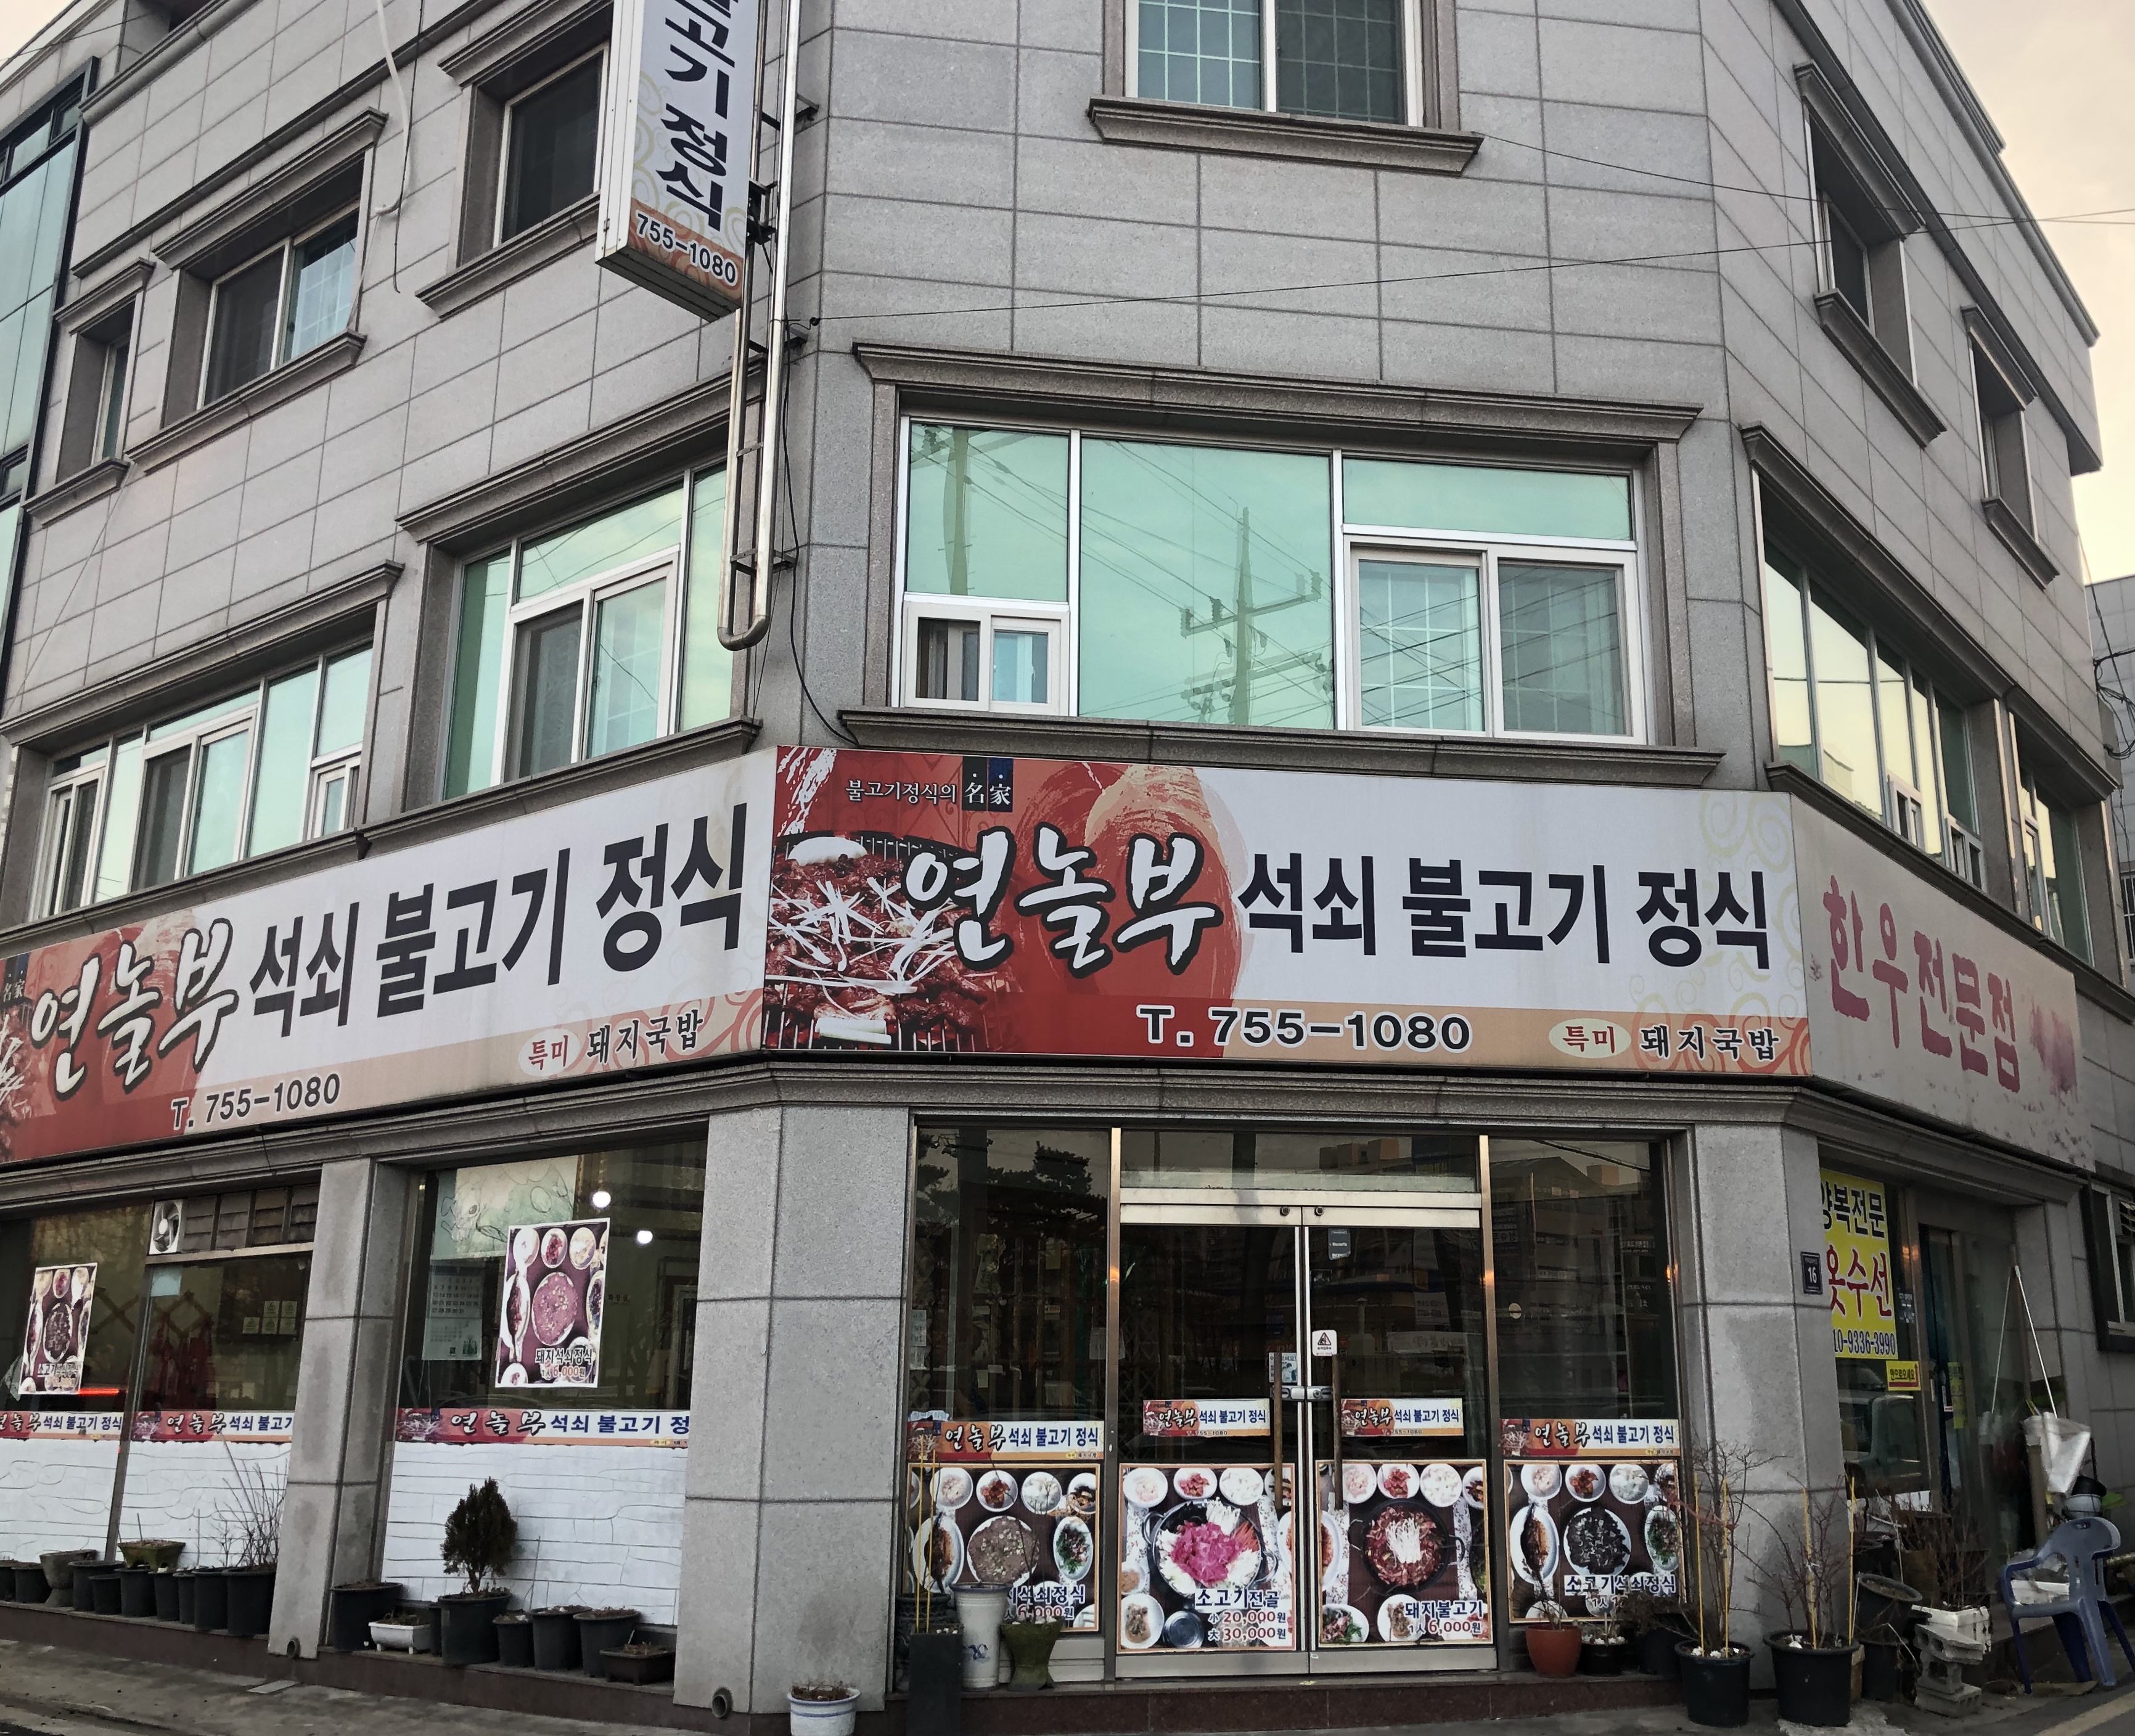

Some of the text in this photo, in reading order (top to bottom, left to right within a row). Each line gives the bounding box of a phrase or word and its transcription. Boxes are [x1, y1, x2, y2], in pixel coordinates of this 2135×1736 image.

[655, 0, 739, 232] 고기 정식
[637, 213, 736, 284] 755-1080
[845, 779, 1012, 805] 불고기정식의 名家
[903, 822, 1770, 978] 연놀부 석쇠 불고기 정식
[31, 803, 747, 1100] 연놀부 석쇠 불고기 정식
[1823, 875, 2020, 1094] 한우전문점
[528, 1009, 703, 1070] 특미 돼지국밥
[1210, 1009, 1471, 1051] 755-1080
[1563, 1025, 1779, 1060] 특미 돼지국밥
[206, 1073, 340, 1124] 755-1080
[1808, 1266, 1817, 1284] 16
[1827, 1244, 1892, 1317] 옷수선
[535, 1348, 592, 1364] 돼지석쇠정식
[44, 1415, 63, 1430] 석쇠
[66, 1415, 97, 1430] 불고기
[167, 1412, 227, 1435] 연놀부
[229, 1415, 253, 1431] 석쇠
[451, 1410, 546, 1436] 연놀부
[551, 1415, 589, 1433] 석쇠
[597, 1415, 661, 1434] 불고기
[1158, 1407, 1266, 1428] 연놀부 석쇠 불고기 정식
[1354, 1407, 1459, 1427] 연놀부 석쇠 불고기 정식
[945, 1423, 1099, 1451] 연놀부 석쇠 불고기 정식
[1535, 1422, 1674, 1449] 연놀부 석쇠 불고기 정식
[1195, 1587, 1280, 1608] 소고기전골
[1565, 1575, 1675, 1594] 소고기석쇠정식
[1223, 1611, 1286, 1624] 20,000원
[1405, 1601, 1483, 1618] 돼지불고기
[1223, 1627, 1286, 1641] 30,000원
[1428, 1619, 1481, 1634] 6,000원
